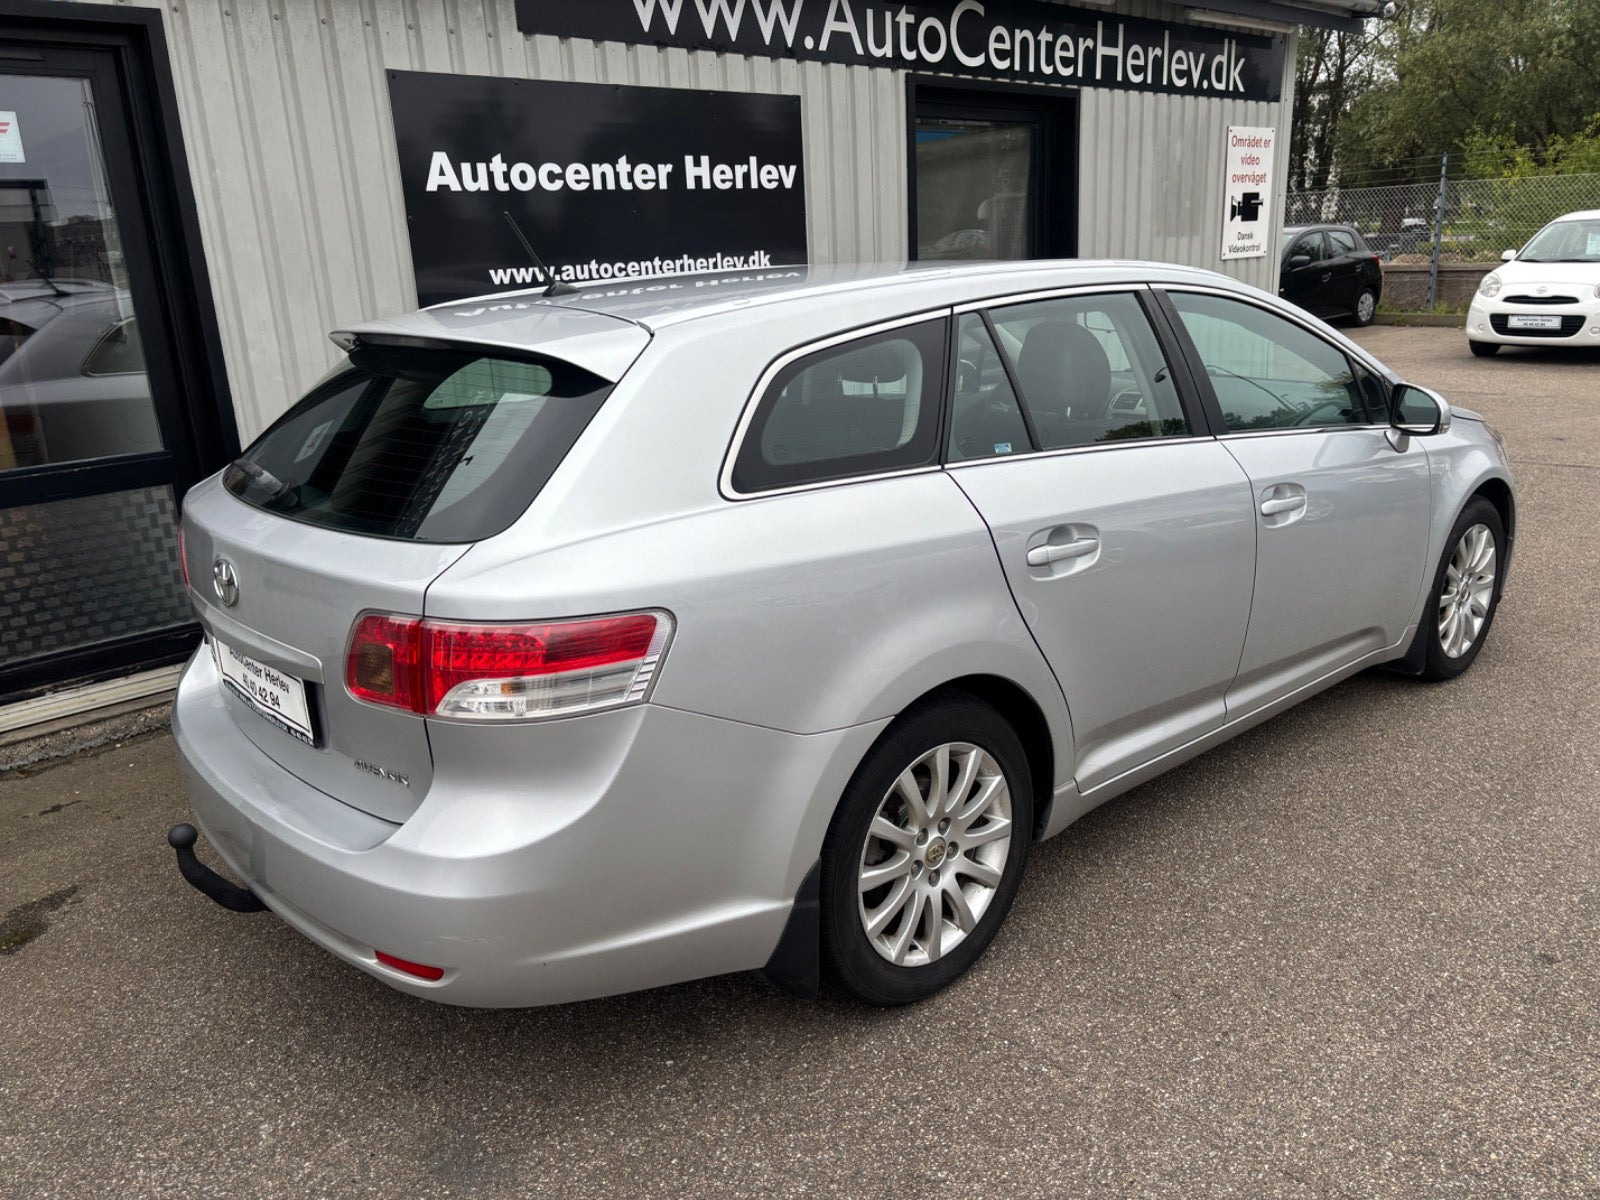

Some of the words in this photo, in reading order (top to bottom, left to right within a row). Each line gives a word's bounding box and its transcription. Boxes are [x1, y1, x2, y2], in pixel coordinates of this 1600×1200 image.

[1231, 134, 1263, 148] Området
[1263, 138, 1271, 149] er
[1240, 153, 1260, 166] video
[426, 151, 673, 192] Autocenter
[684, 155, 797, 190] Herlev
[1231, 171, 1267, 186] overvåget
[1237, 231, 1254, 240] Dansk
[488, 250, 771, 286] www.autocenterherlev.dk
[264, 667, 289, 694] Herlev
[258, 686, 269, 704] 42
[269, 691, 281, 709] 94
